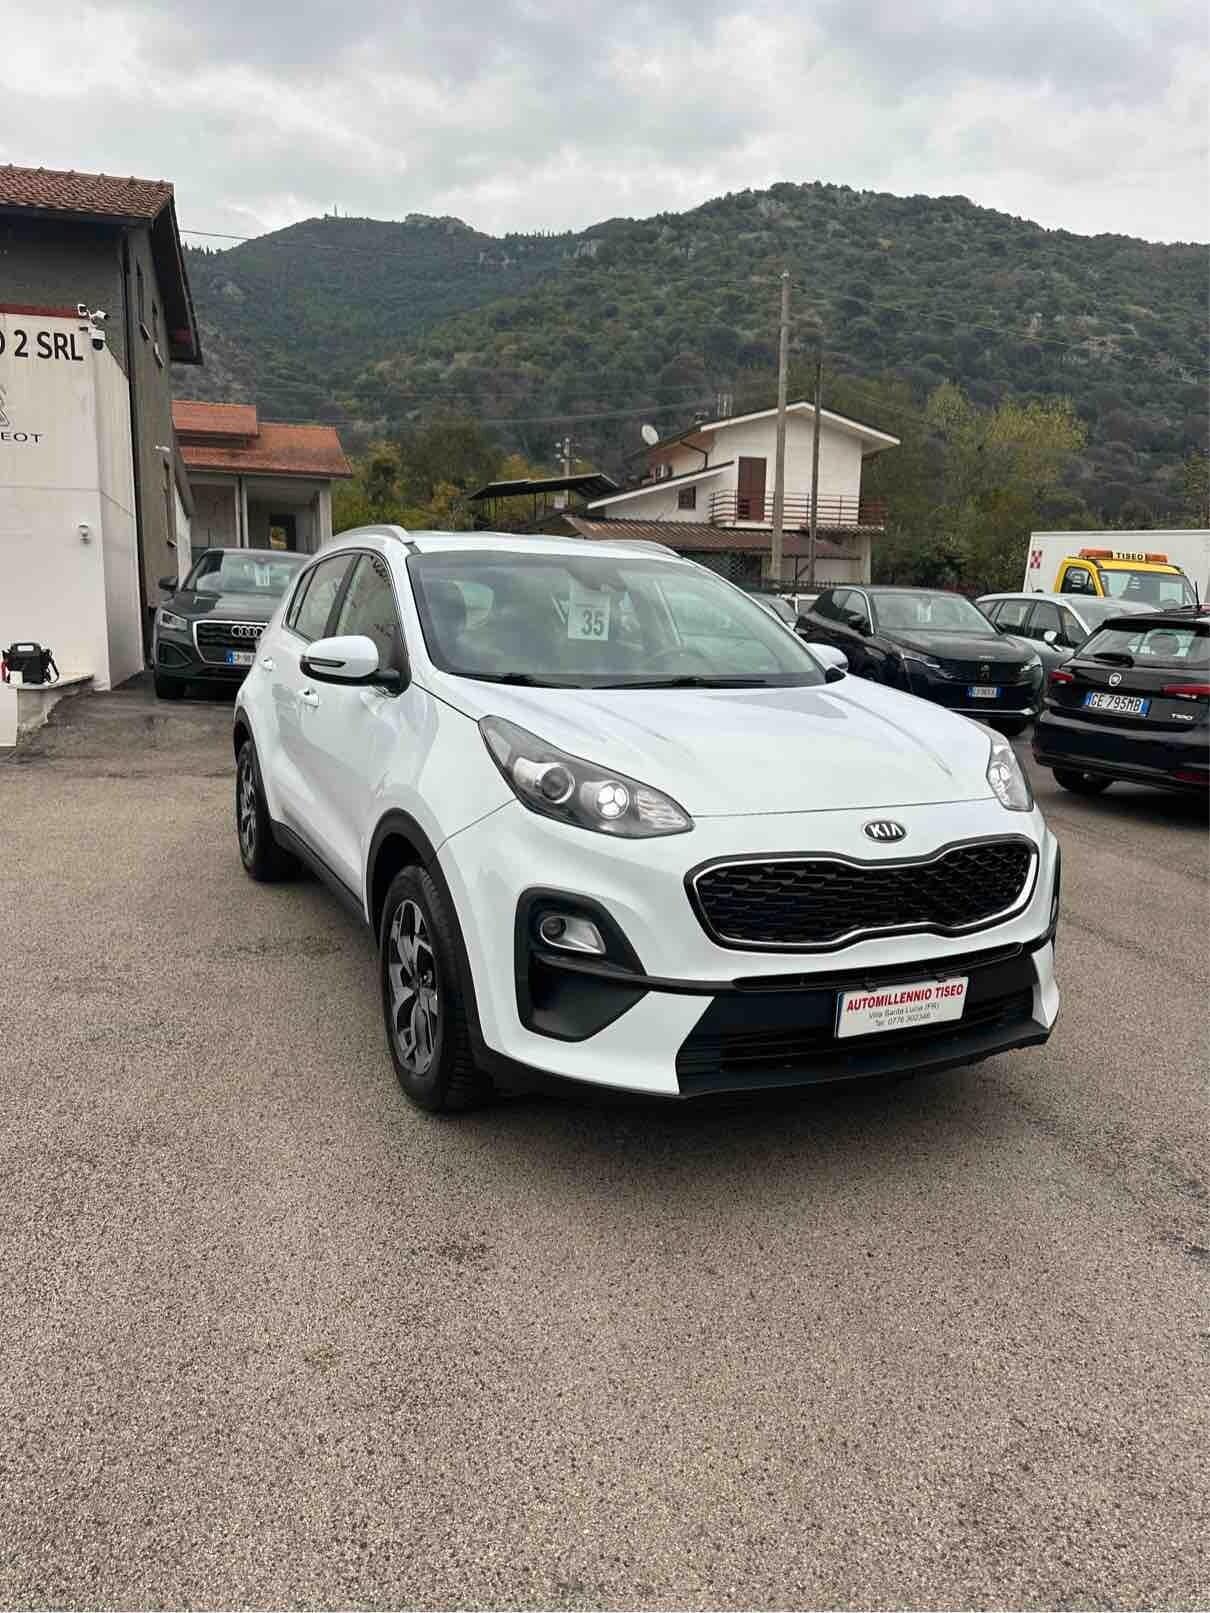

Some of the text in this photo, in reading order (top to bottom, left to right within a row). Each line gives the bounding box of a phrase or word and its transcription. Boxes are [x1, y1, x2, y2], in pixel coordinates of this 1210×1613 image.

[13, 329, 29, 358] 2
[36, 331, 84, 361] SRL
[581, 609, 604, 636] 35
[1106, 695, 1142, 713] 795MB
[869, 823, 903, 837] KIA
[847, 983, 964, 1012] AUTOMILLENNIO TISEO
